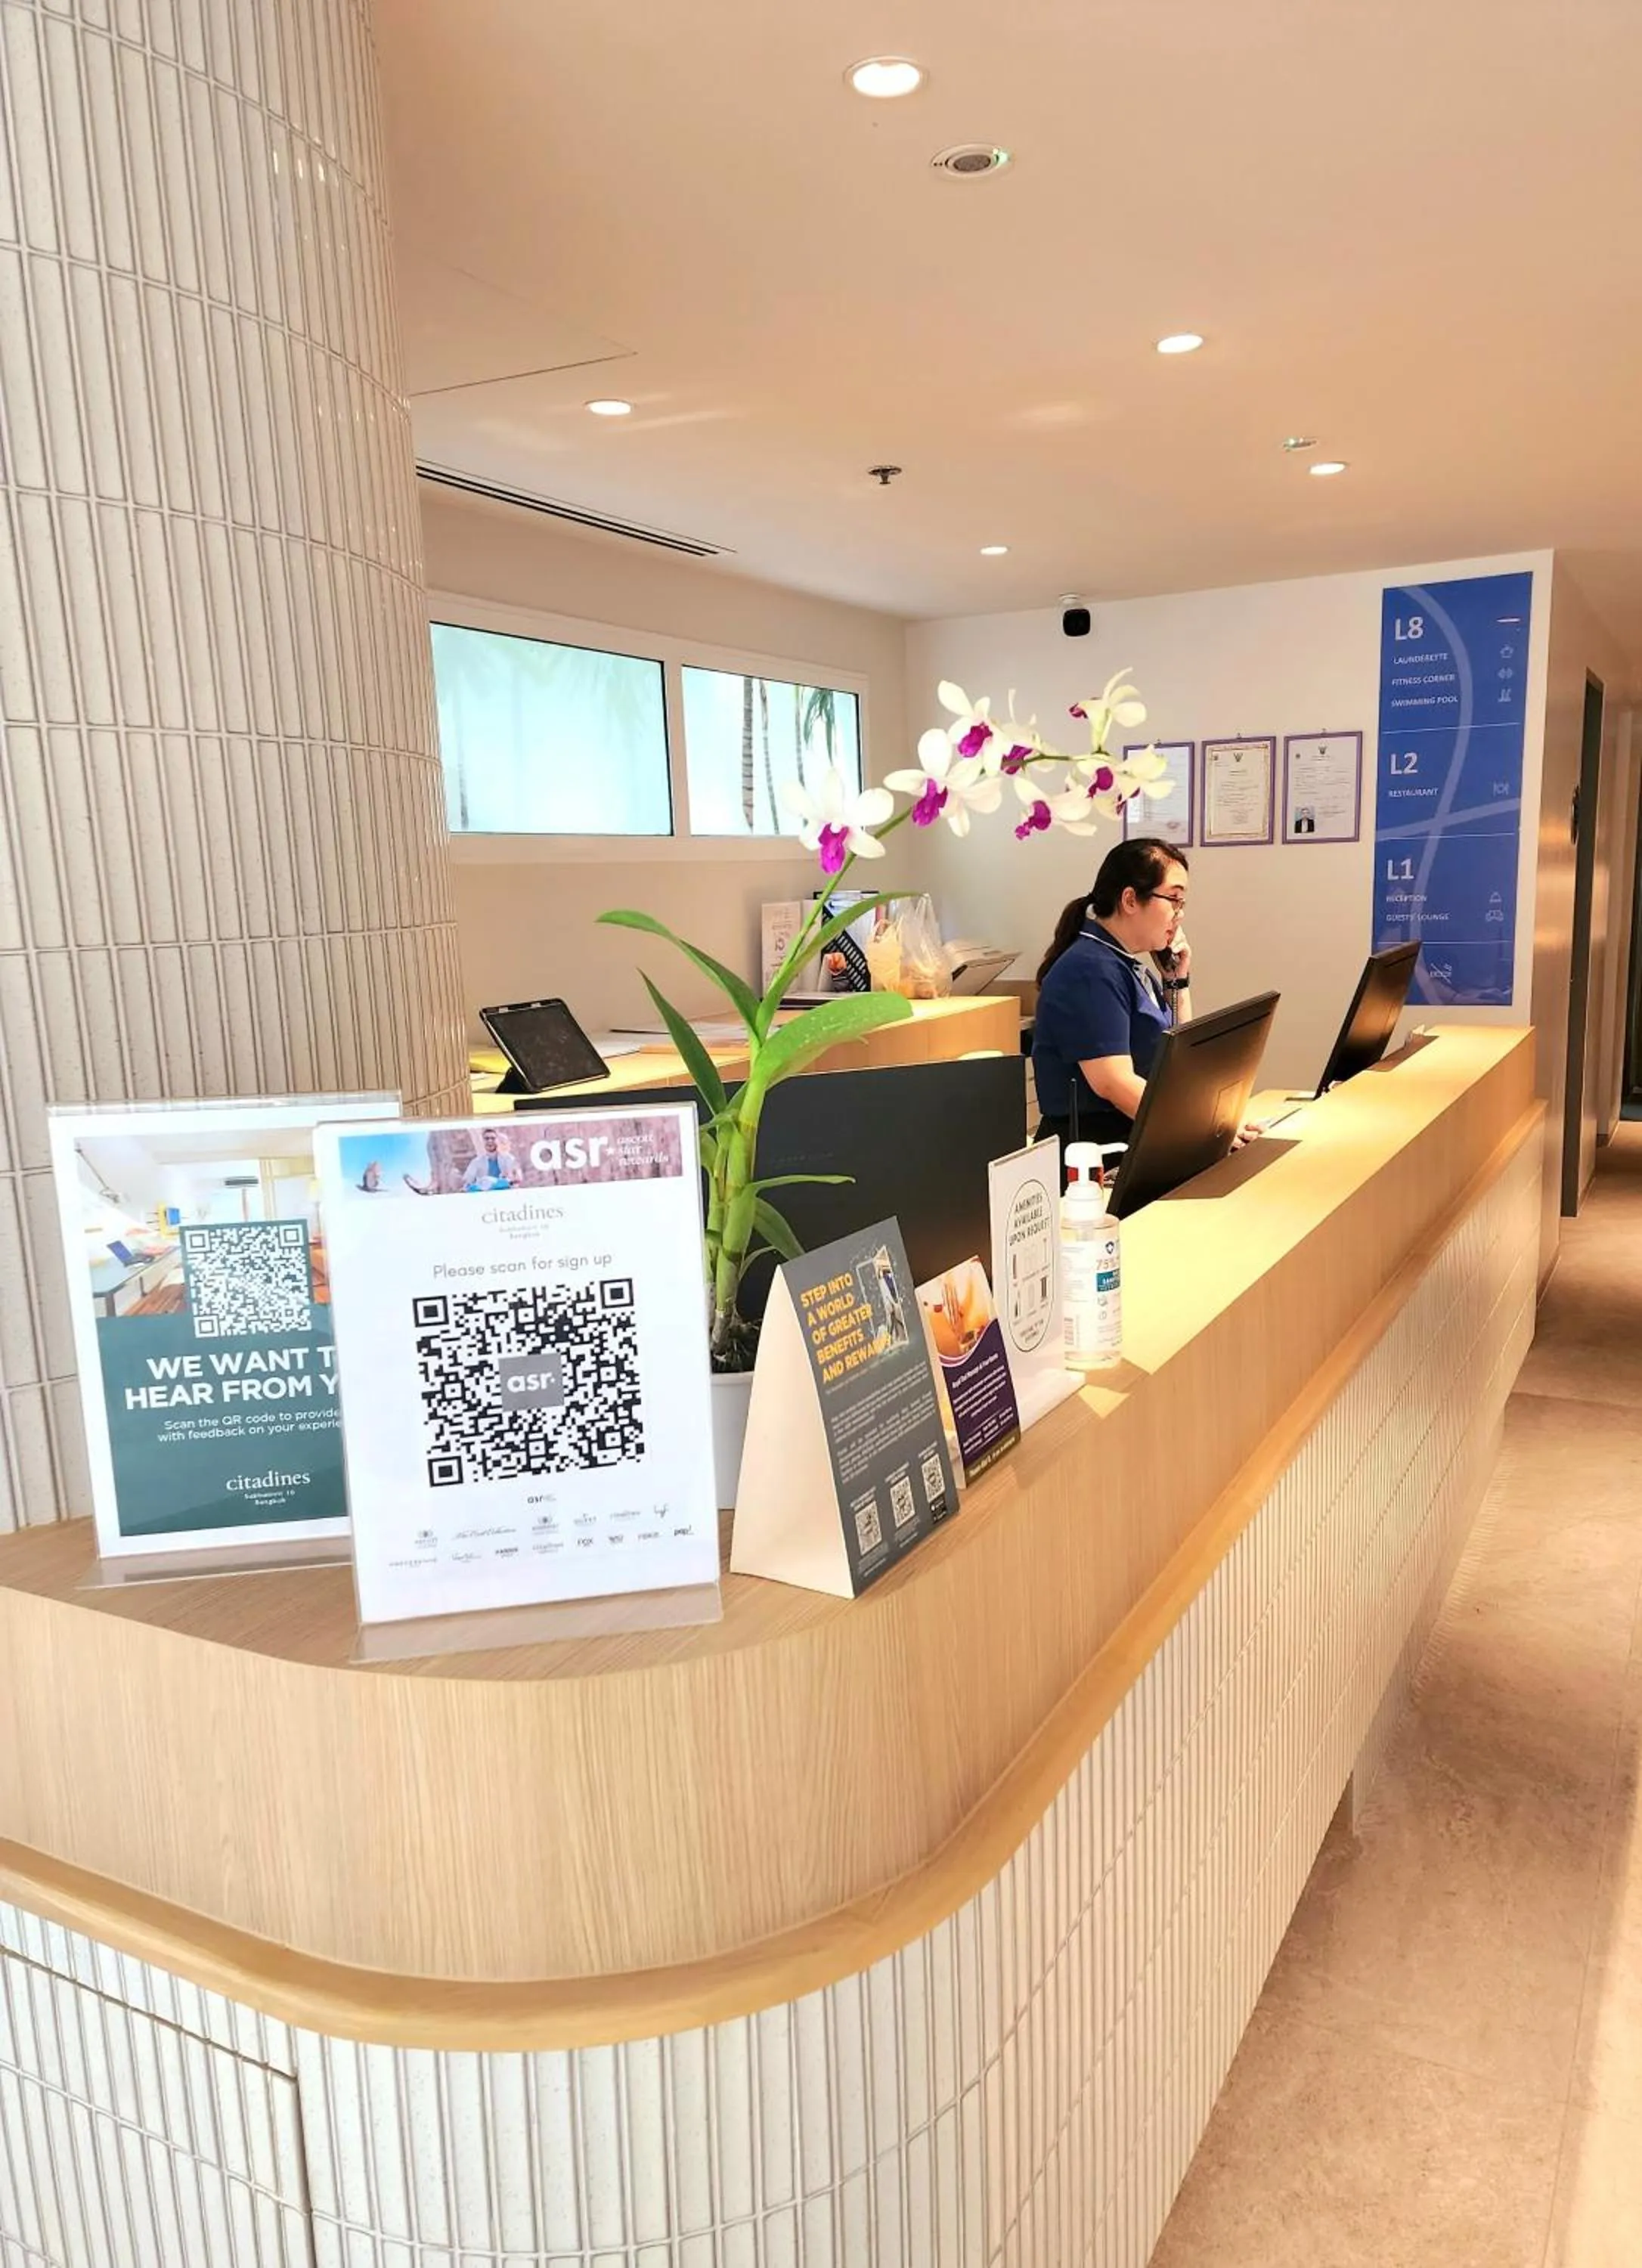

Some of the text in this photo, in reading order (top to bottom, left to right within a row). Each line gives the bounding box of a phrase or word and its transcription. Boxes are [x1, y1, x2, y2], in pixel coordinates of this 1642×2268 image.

[1395, 616, 1424, 640] L8
[1392, 674, 1455, 686] FITNESS CORNER
[1391, 695, 1458, 708] SWIMMING POOL
[1390, 752, 1418, 775] L2
[1389, 788, 1439, 798] RESTAURANT
[1387, 858, 1414, 881] L1
[1386, 894, 1427, 903] RECEPTION
[530, 1136, 608, 1171] asr
[482, 1204, 564, 1224] citadines
[433, 1253, 612, 1279] Please scan for sign up
[801, 1272, 854, 1308] STEP INTO
[807, 1294, 854, 1327] A WORLD
[812, 1303, 872, 1344] OF GREATER
[816, 1328, 865, 1365] BENEFITS
[147, 1346, 337, 1380] WE WANT T
[823, 1362, 844, 1383] AND
[124, 1374, 339, 1410] HEAR FROM Y
[507, 1372, 553, 1393] asr
[158, 1430, 184, 1442] with
[188, 1427, 246, 1439] feedback
[249, 1426, 264, 1434] on
[268, 1423, 296, 1435] your
[164, 1420, 195, 1430] Scan
[198, 1418, 218, 1428] the
[222, 1414, 241, 1425] QR
[245, 1412, 275, 1424] code
[279, 1412, 292, 1421] to
[226, 1470, 311, 1490] citadines
